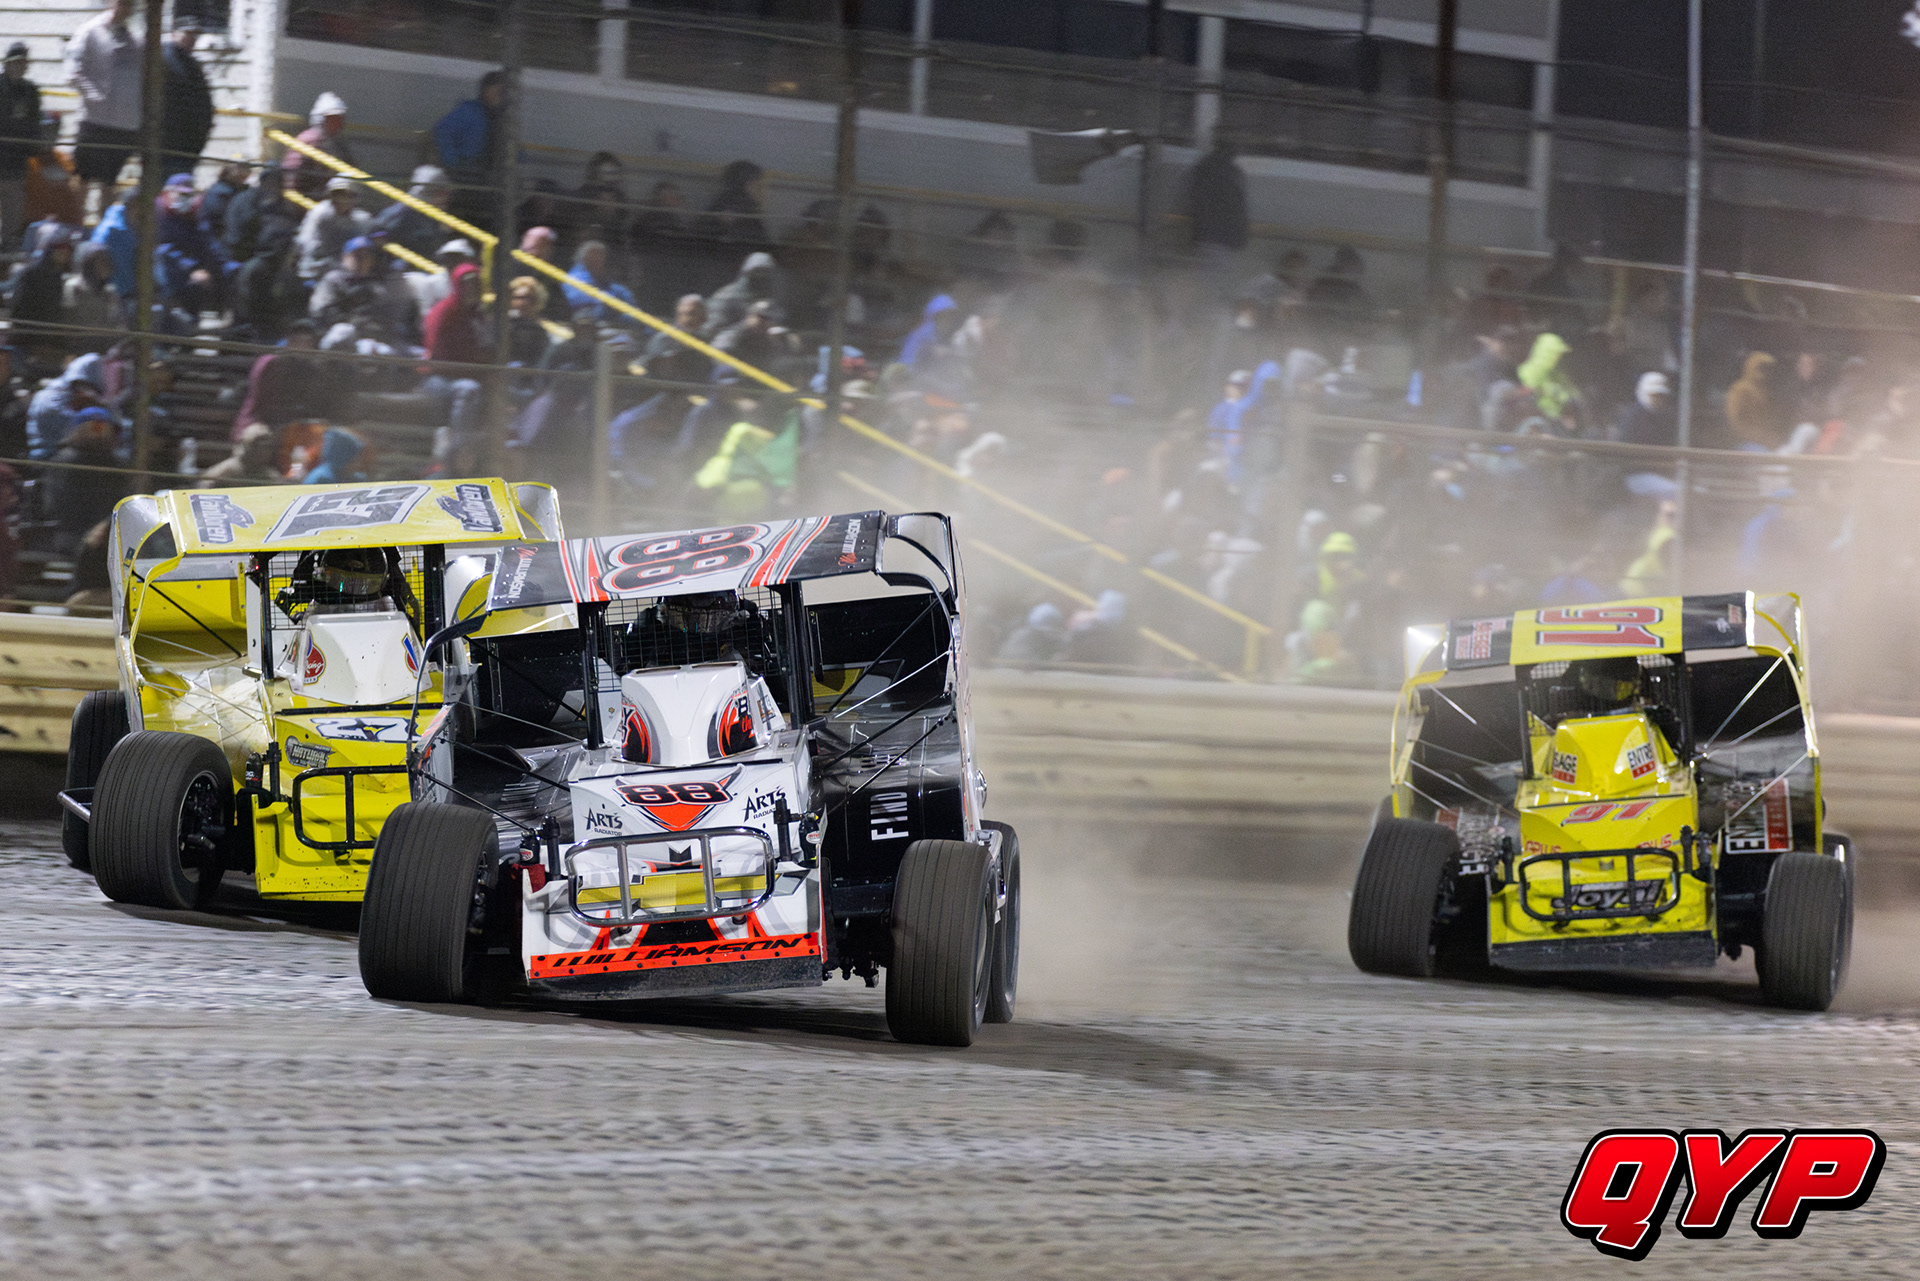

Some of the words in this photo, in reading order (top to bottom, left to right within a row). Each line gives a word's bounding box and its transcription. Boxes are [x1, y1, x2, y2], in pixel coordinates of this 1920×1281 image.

[603, 523, 769, 593] 88
[1536, 606, 1664, 648] 91
[616, 782, 731, 806] 88
[870, 792, 909, 840] FIND
[1562, 800, 1658, 825] 91
[552, 938, 803, 967] WILLIAMSON
